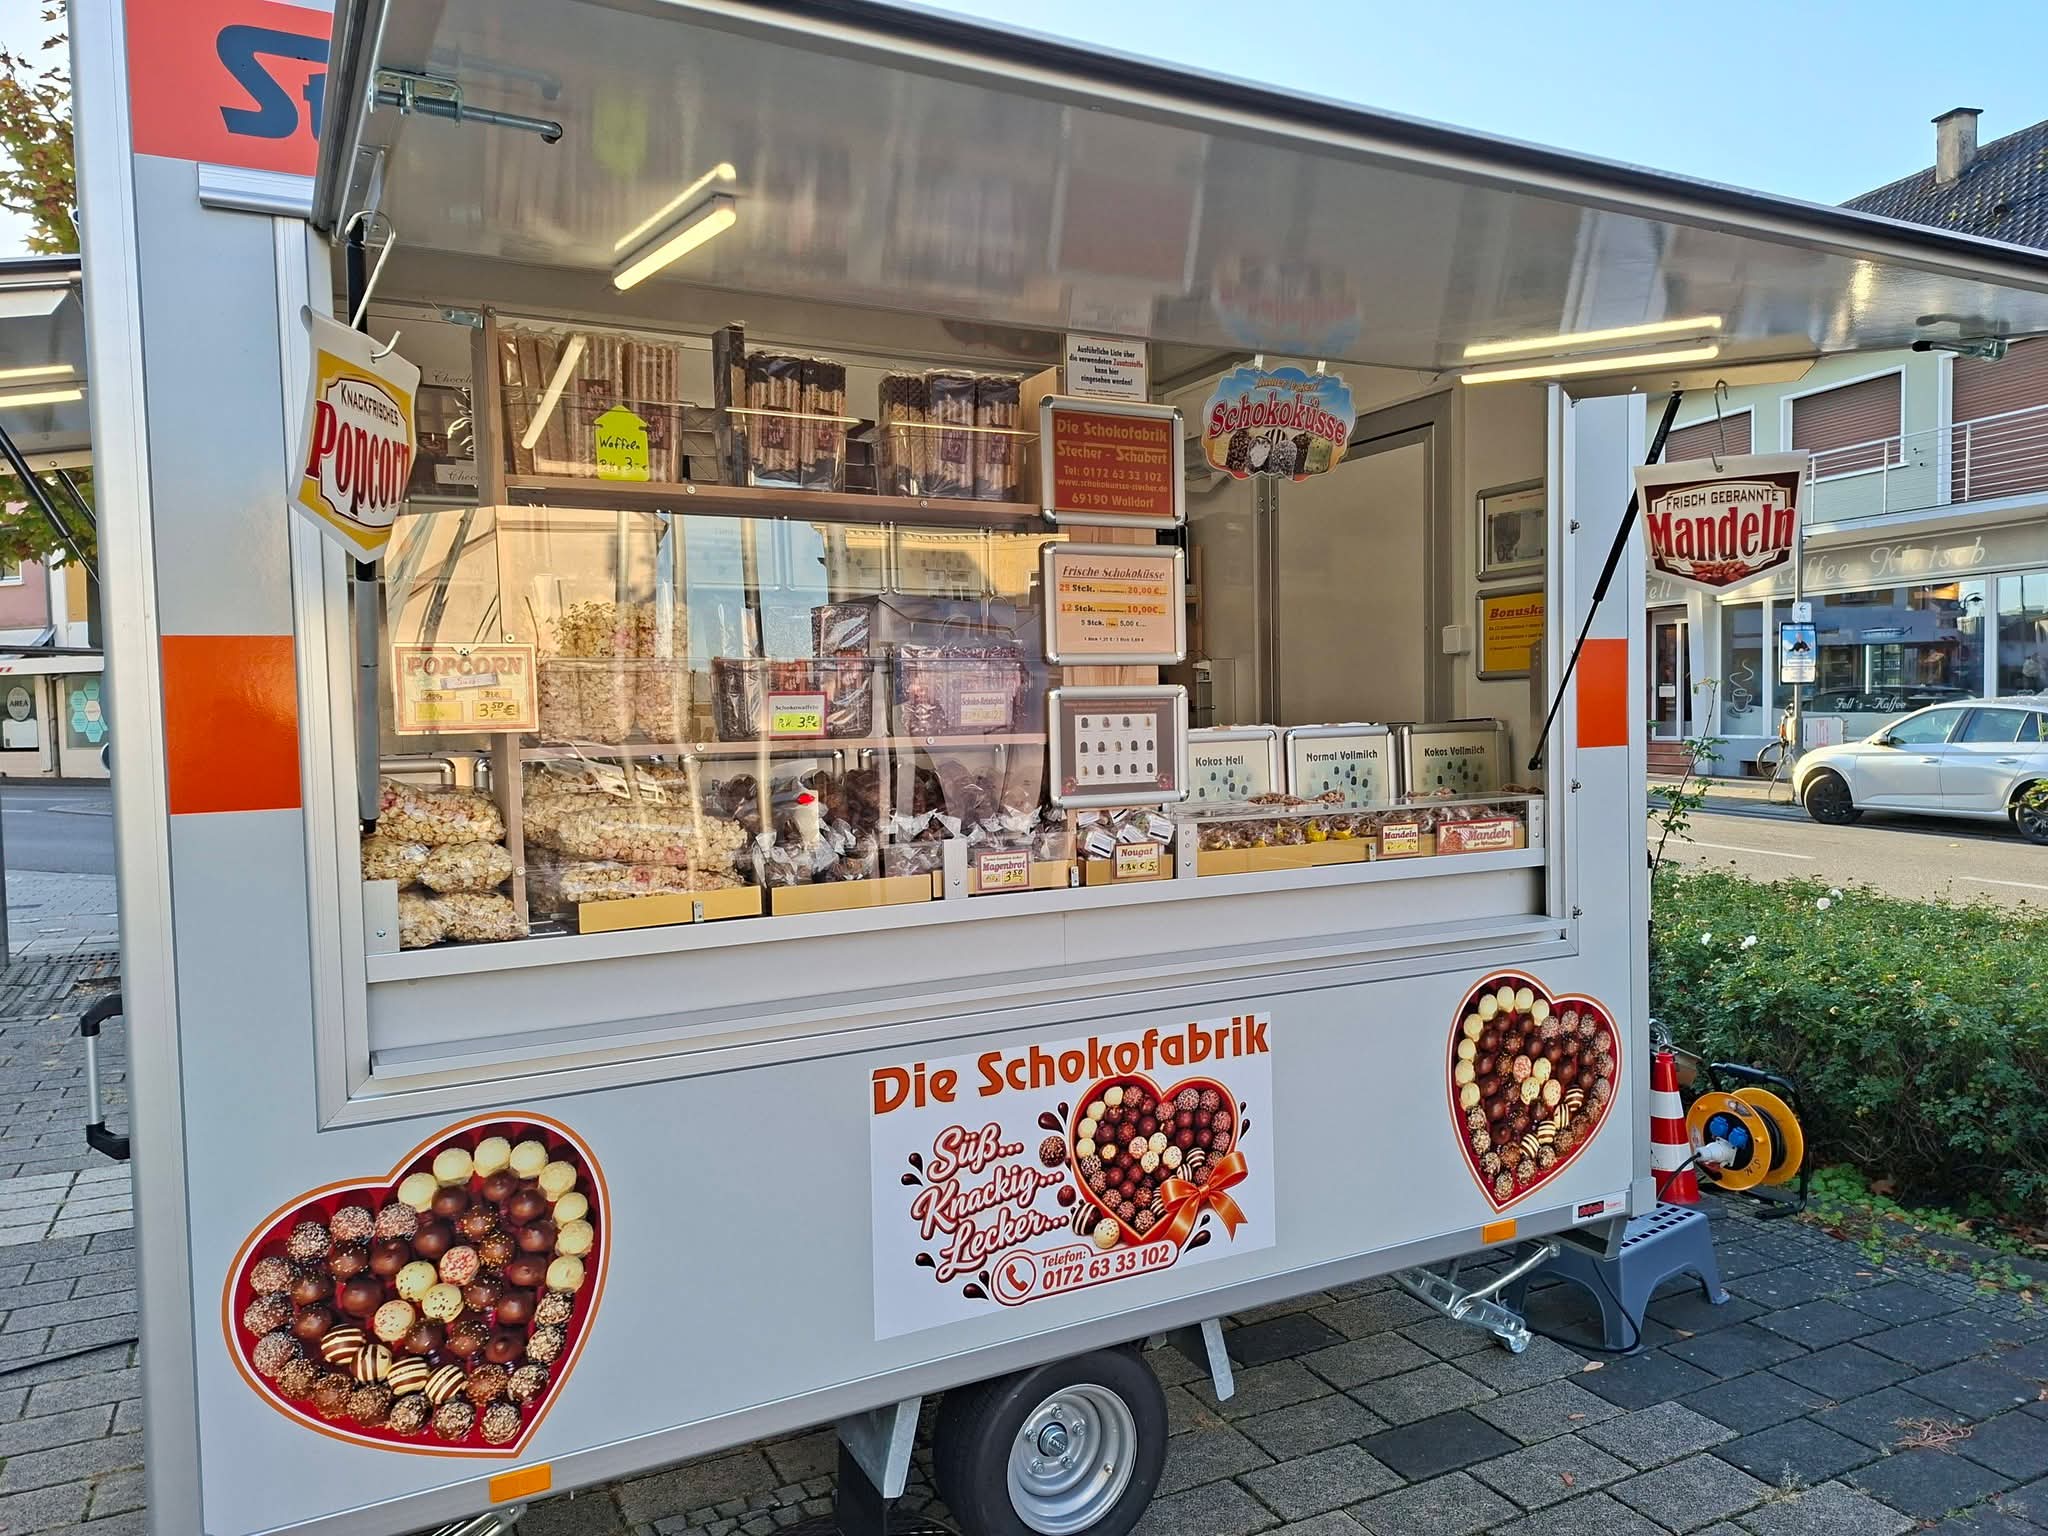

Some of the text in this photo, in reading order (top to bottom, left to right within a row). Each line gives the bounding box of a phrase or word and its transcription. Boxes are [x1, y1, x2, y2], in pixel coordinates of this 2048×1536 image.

[1069, 353, 1078, 361] die
[1077, 345, 1136, 359] Ausführliche Liste über
[1108, 367, 1119, 376] hier
[1081, 374, 1133, 386] eingesehen werden!
[341, 383, 400, 427] KNACKFRISCHES
[1209, 391, 1347, 446] Schokoküsse
[1057, 419, 1168, 443] Die Schokofabrik
[305, 400, 411, 517] Popcorn
[1057, 440, 1103, 459] Stecher
[1116, 446, 1168, 465] Schubert
[1064, 465, 1162, 482] Tel: 0172 63 33 102
[1071, 493, 1155, 508] 69190 Walldorf
[1666, 488, 1779, 511] FRISCH GEBRANNTE
[1646, 503, 1796, 561] Mandeln
[1062, 565, 1166, 580] Frische Schokoküsse
[1127, 586, 1152, 596] 20,00
[1061, 603, 1073, 612] 12
[406, 656, 523, 676] POPCORN
[8, 700, 29, 708] AREA
[1306, 749, 1378, 763] Normal Vollmilch
[1424, 745, 1486, 757] Kokos Vollmilch
[1195, 755, 1244, 767] Kokos Hell
[1384, 831, 1417, 840] Mandeln
[1469, 828, 1512, 841] Mandeln
[1121, 848, 1153, 858] Nougat
[983, 861, 1025, 873] Magenbrot
[872, 1015, 1270, 1116] Die Schokofabrik
[927, 1122, 1024, 1182] Süß...
[912, 1165, 1064, 1241] Knackig...
[936, 1206, 1069, 1284] Lecker...
[1041, 1250, 1087, 1269] Telefon:
[1042, 1244, 1169, 1290] 0172 63 33 102
